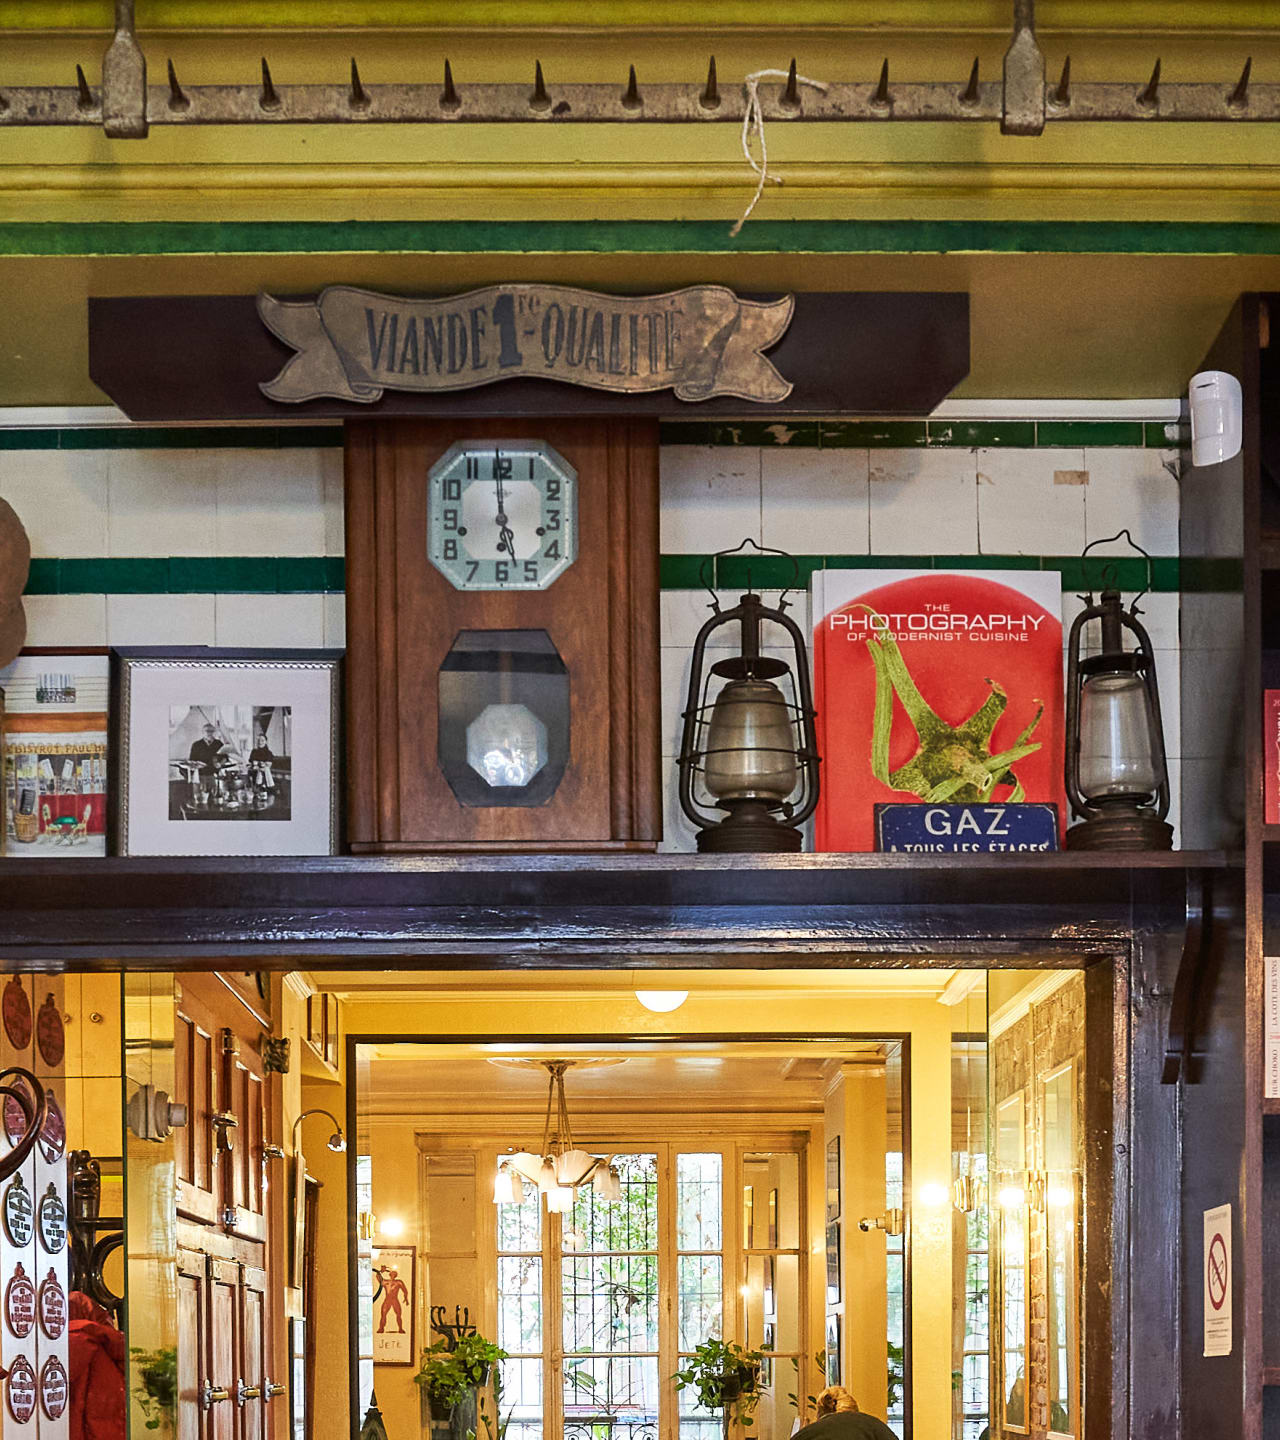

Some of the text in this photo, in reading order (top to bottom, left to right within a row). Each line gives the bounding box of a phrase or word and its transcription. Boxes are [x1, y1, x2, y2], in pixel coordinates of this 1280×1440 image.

[364, 306, 488, 376] VIANDE
[467, 458, 478, 480] 11
[442, 479, 461, 500] 10
[546, 480, 560, 501] 2
[443, 509, 458, 531] 9
[546, 510, 560, 531] 3
[443, 539, 458, 560] 8
[544, 539, 561, 561] 4
[465, 561, 479, 582] 7
[495, 561, 508, 582] 6
[524, 561, 538, 582] 5
[924, 603, 951, 612] THE
[829, 614, 1046, 631] PHOTOGRAPHY
[846, 632, 1029, 642] OF MODERNIST CUISINE
[924, 808, 1009, 836] GAZ
